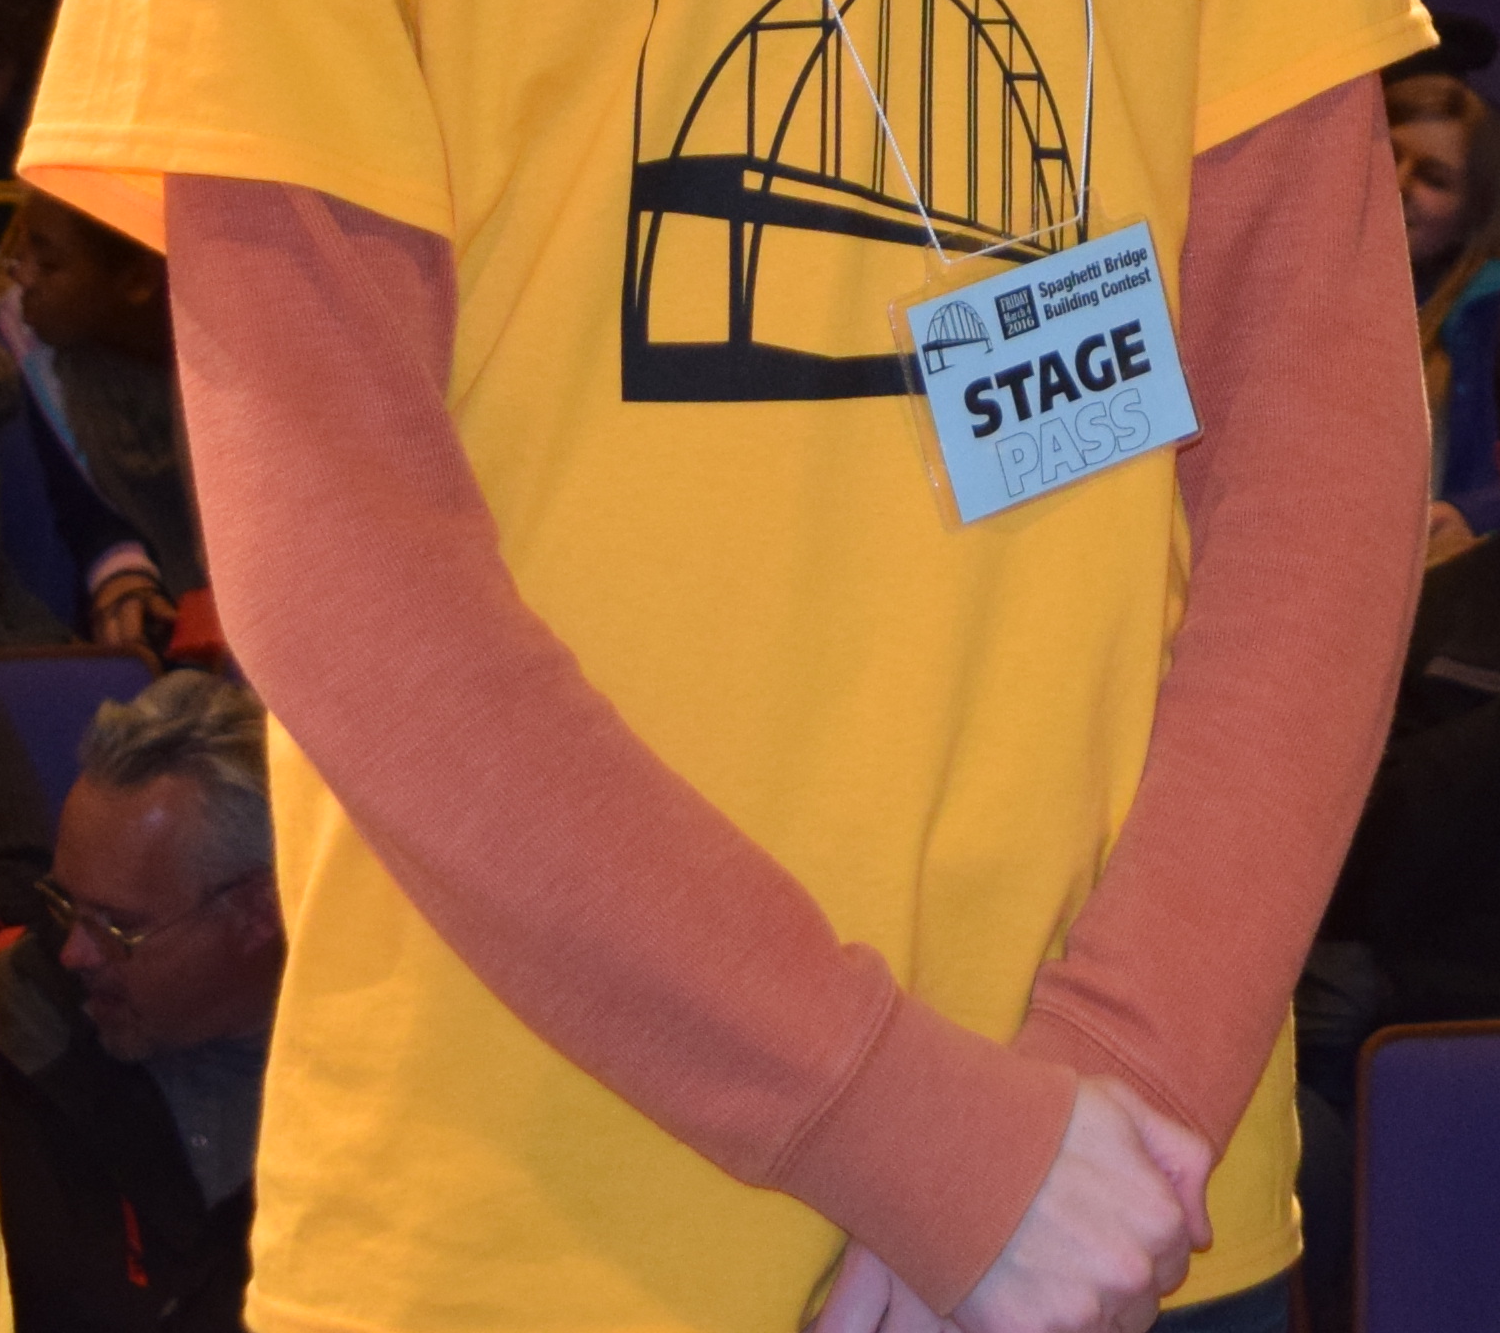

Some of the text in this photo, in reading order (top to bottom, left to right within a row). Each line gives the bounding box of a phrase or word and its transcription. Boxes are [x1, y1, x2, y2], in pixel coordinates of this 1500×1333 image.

[1038, 247, 1148, 299] Spaghetti Bridge
[1043, 267, 1152, 320] Building Contest
[999, 290, 1029, 313] FRIDAY
[1007, 316, 1035, 336] 2016
[964, 319, 1152, 438] STAGE
[995, 388, 1150, 498] PASS
